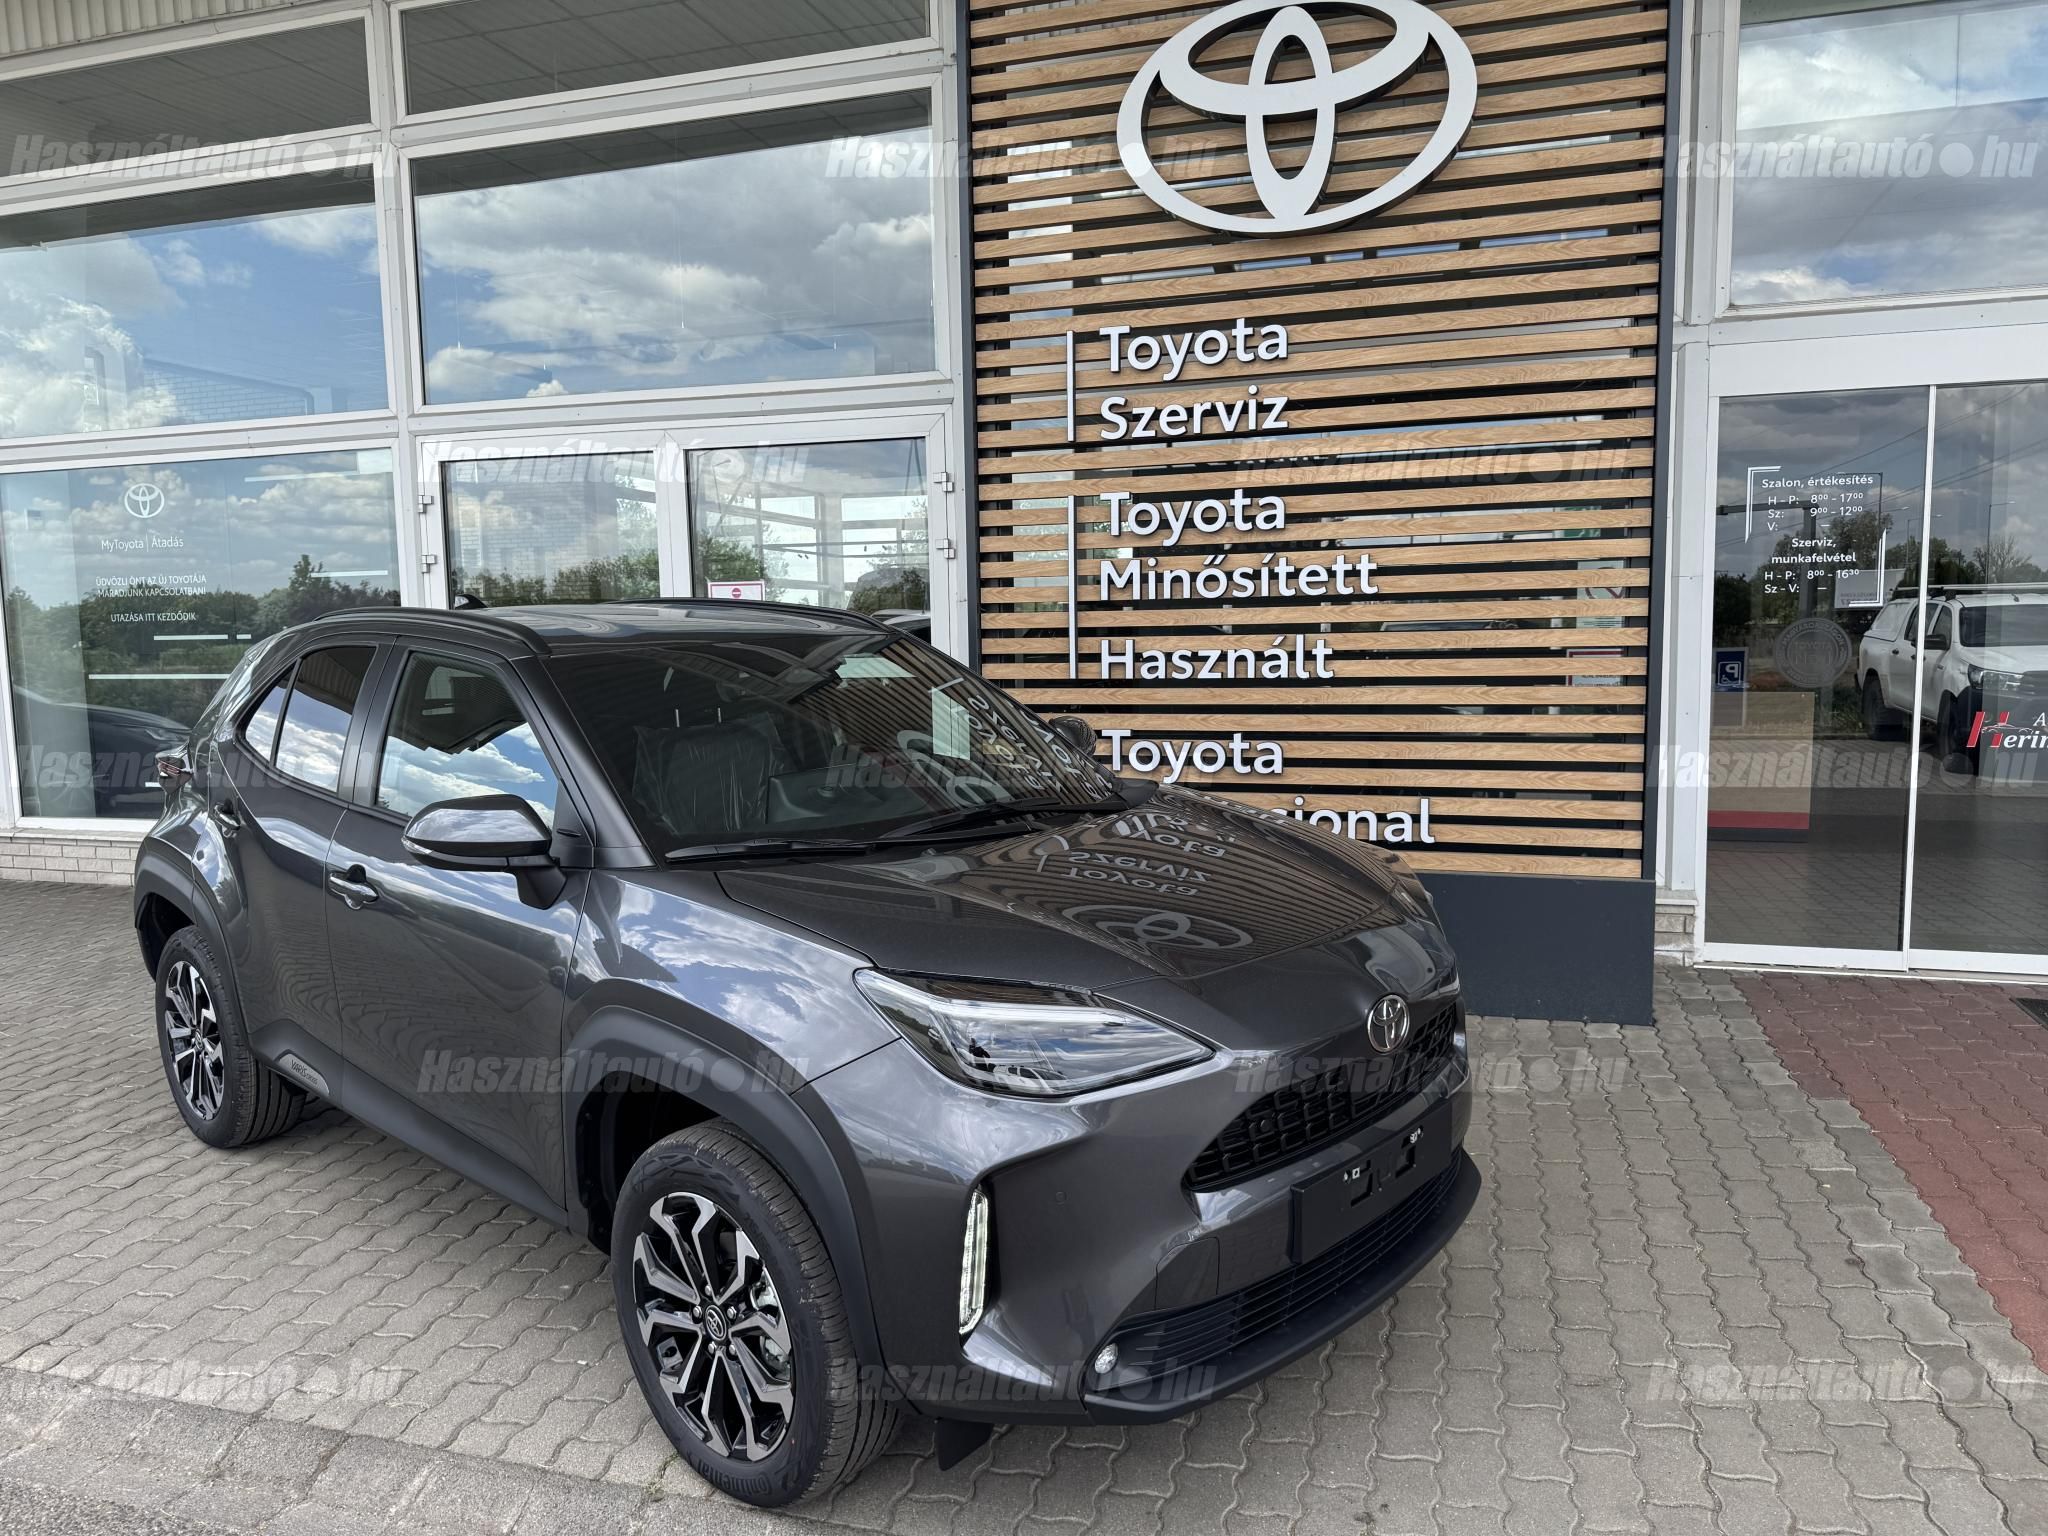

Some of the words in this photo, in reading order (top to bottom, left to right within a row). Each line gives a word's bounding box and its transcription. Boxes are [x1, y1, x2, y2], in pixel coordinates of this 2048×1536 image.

[1099, 318, 1289, 381] Toyota
[1100, 385, 1290, 440] Szerviz
[1761, 478, 1804, 489] Szalon,
[1807, 475, 1874, 487] értékesítés
[1768, 496, 1777, 505] H
[1788, 495, 1800, 505] P:
[1099, 488, 1287, 547] Toyota
[1767, 509, 1785, 518] Sz:
[1767, 522, 1778, 531] V:
[101, 539, 144, 552] MyToyota
[151, 536, 184, 548] Átadás
[1791, 537, 1837, 548] Szerviz,
[1771, 552, 1857, 564] munkafelvétel
[1101, 553, 1379, 601] Minősített
[1764, 571, 1774, 580] H
[1785, 571, 1796, 580] P:
[1764, 584, 1778, 593] Sz
[1789, 584, 1800, 593] V:
[111, 612, 144, 622] UTAZÁSA
[1101, 634, 1334, 680] Használt
[1101, 730, 1284, 784] Toyota
